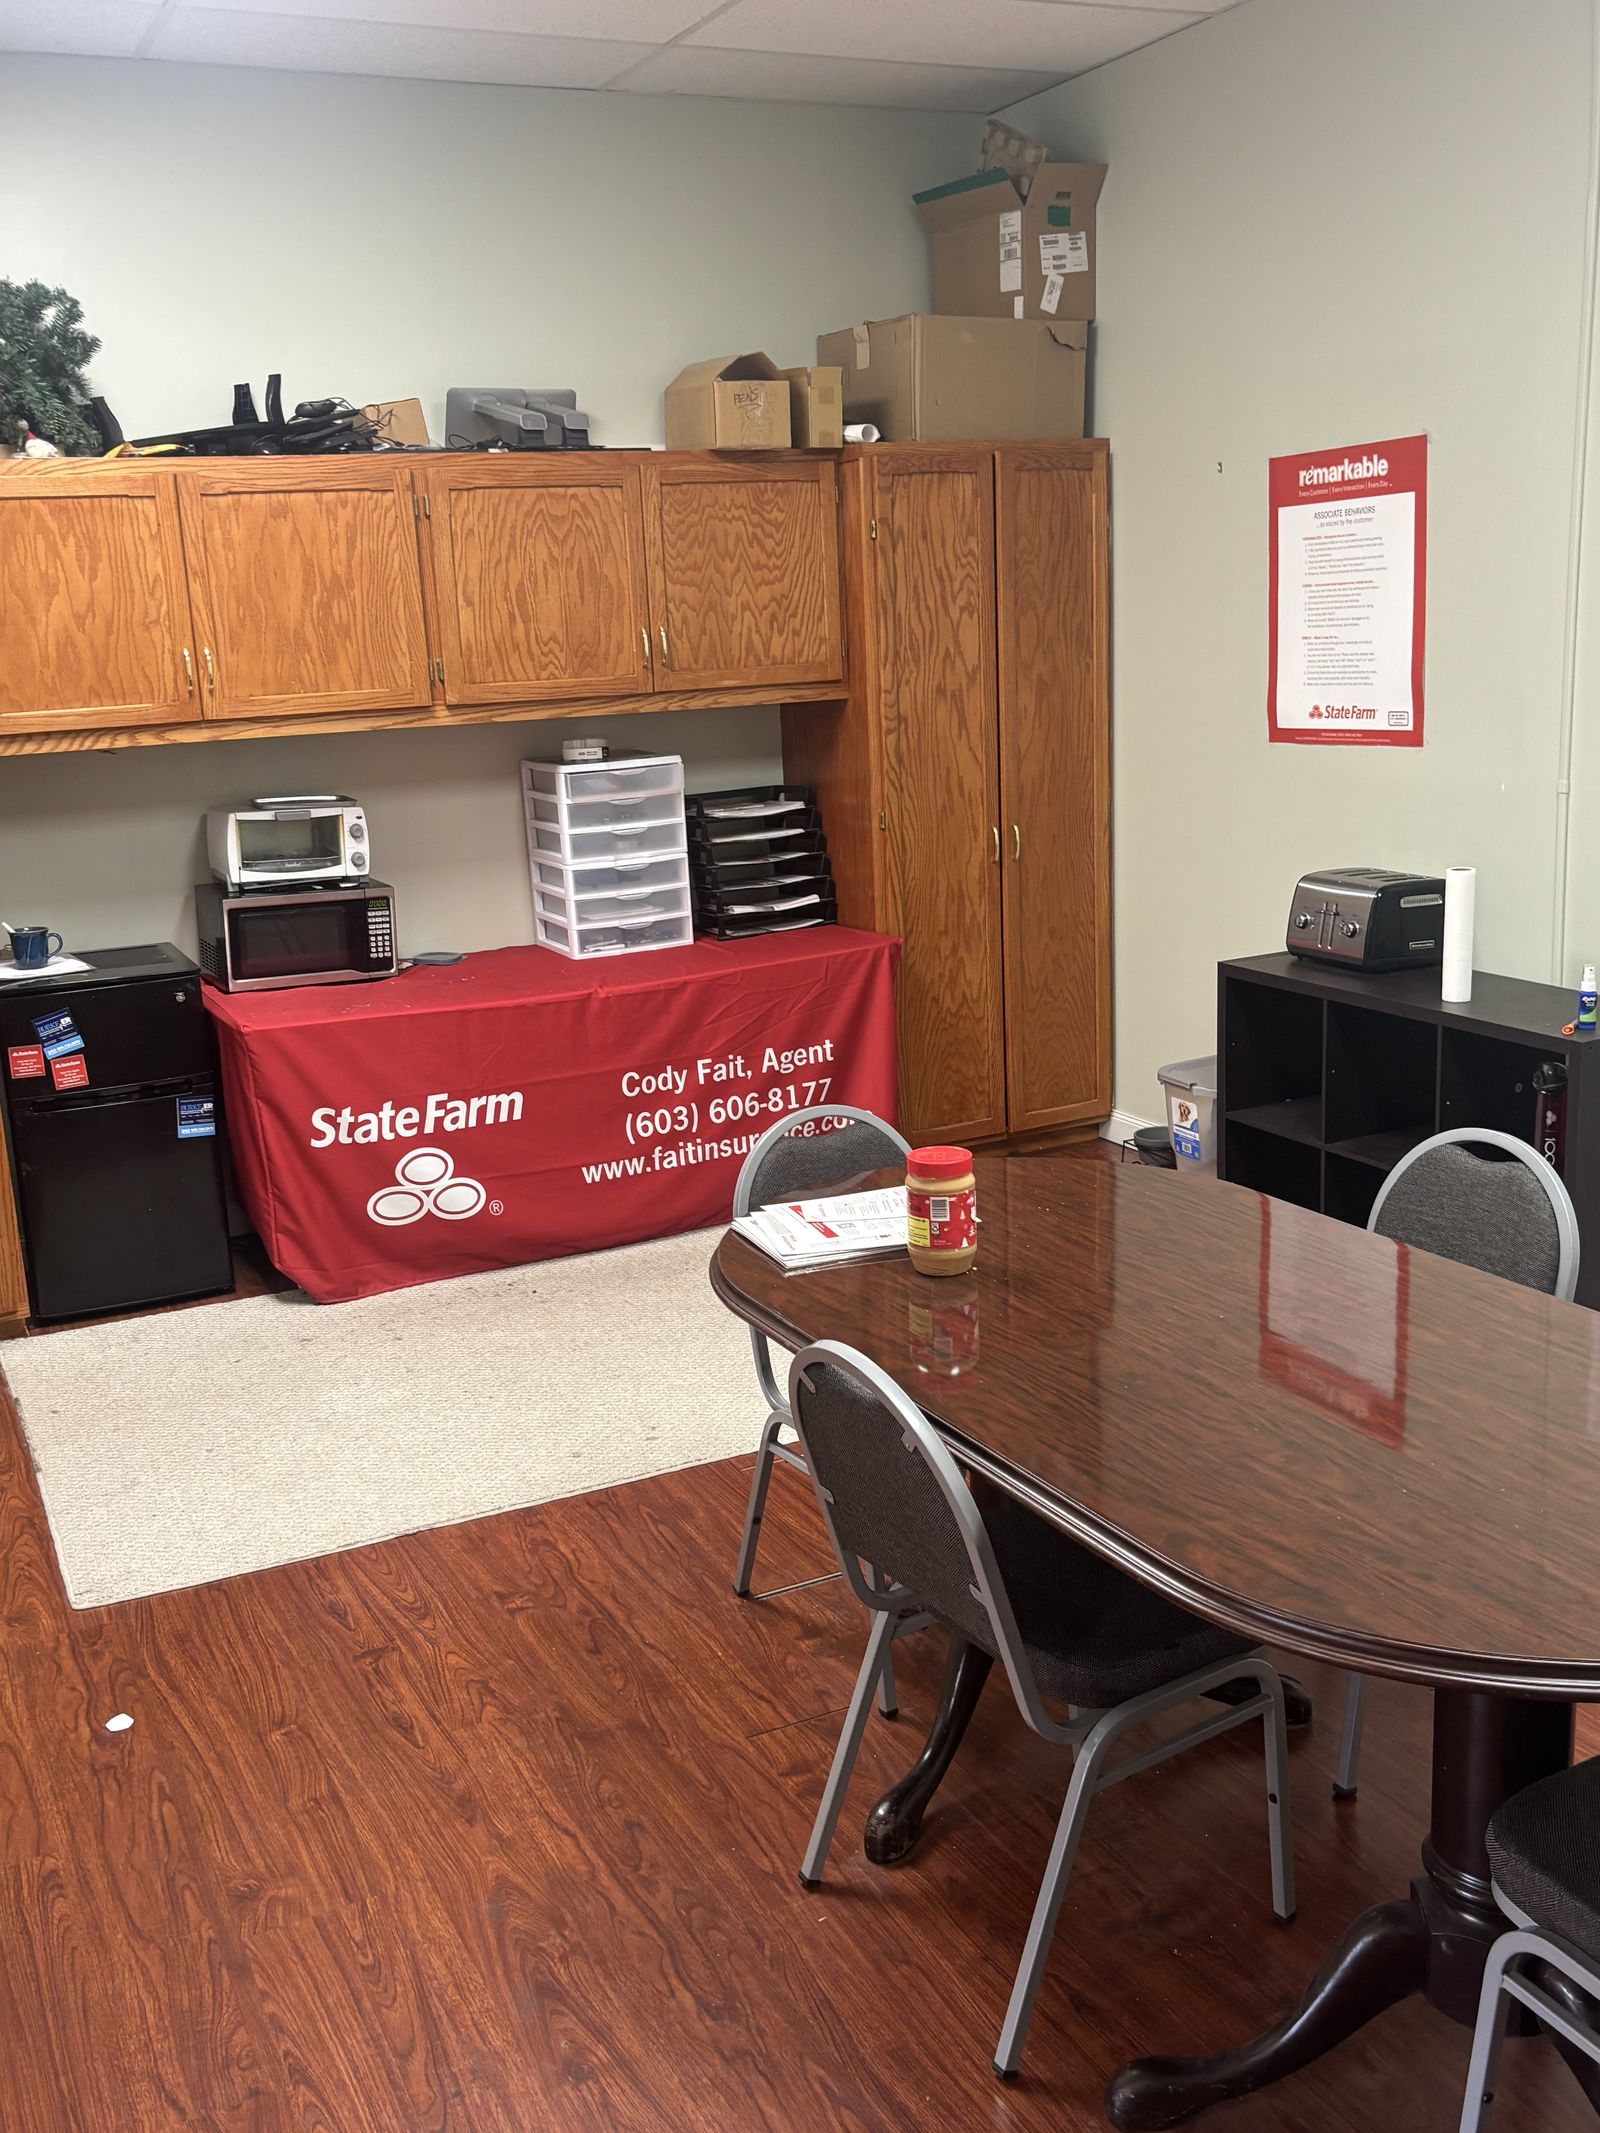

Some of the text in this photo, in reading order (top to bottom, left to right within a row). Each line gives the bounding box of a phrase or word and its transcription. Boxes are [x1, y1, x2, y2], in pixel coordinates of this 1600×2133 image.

[1314, 505, 1376, 520] ASSOCIATE BEHAVIORS
[621, 1039, 834, 1098] Cody Fait, Agent
[625, 1077, 833, 1145] (603) 606-8177
[581, 1110, 873, 1184] www.faitinsurce.co
